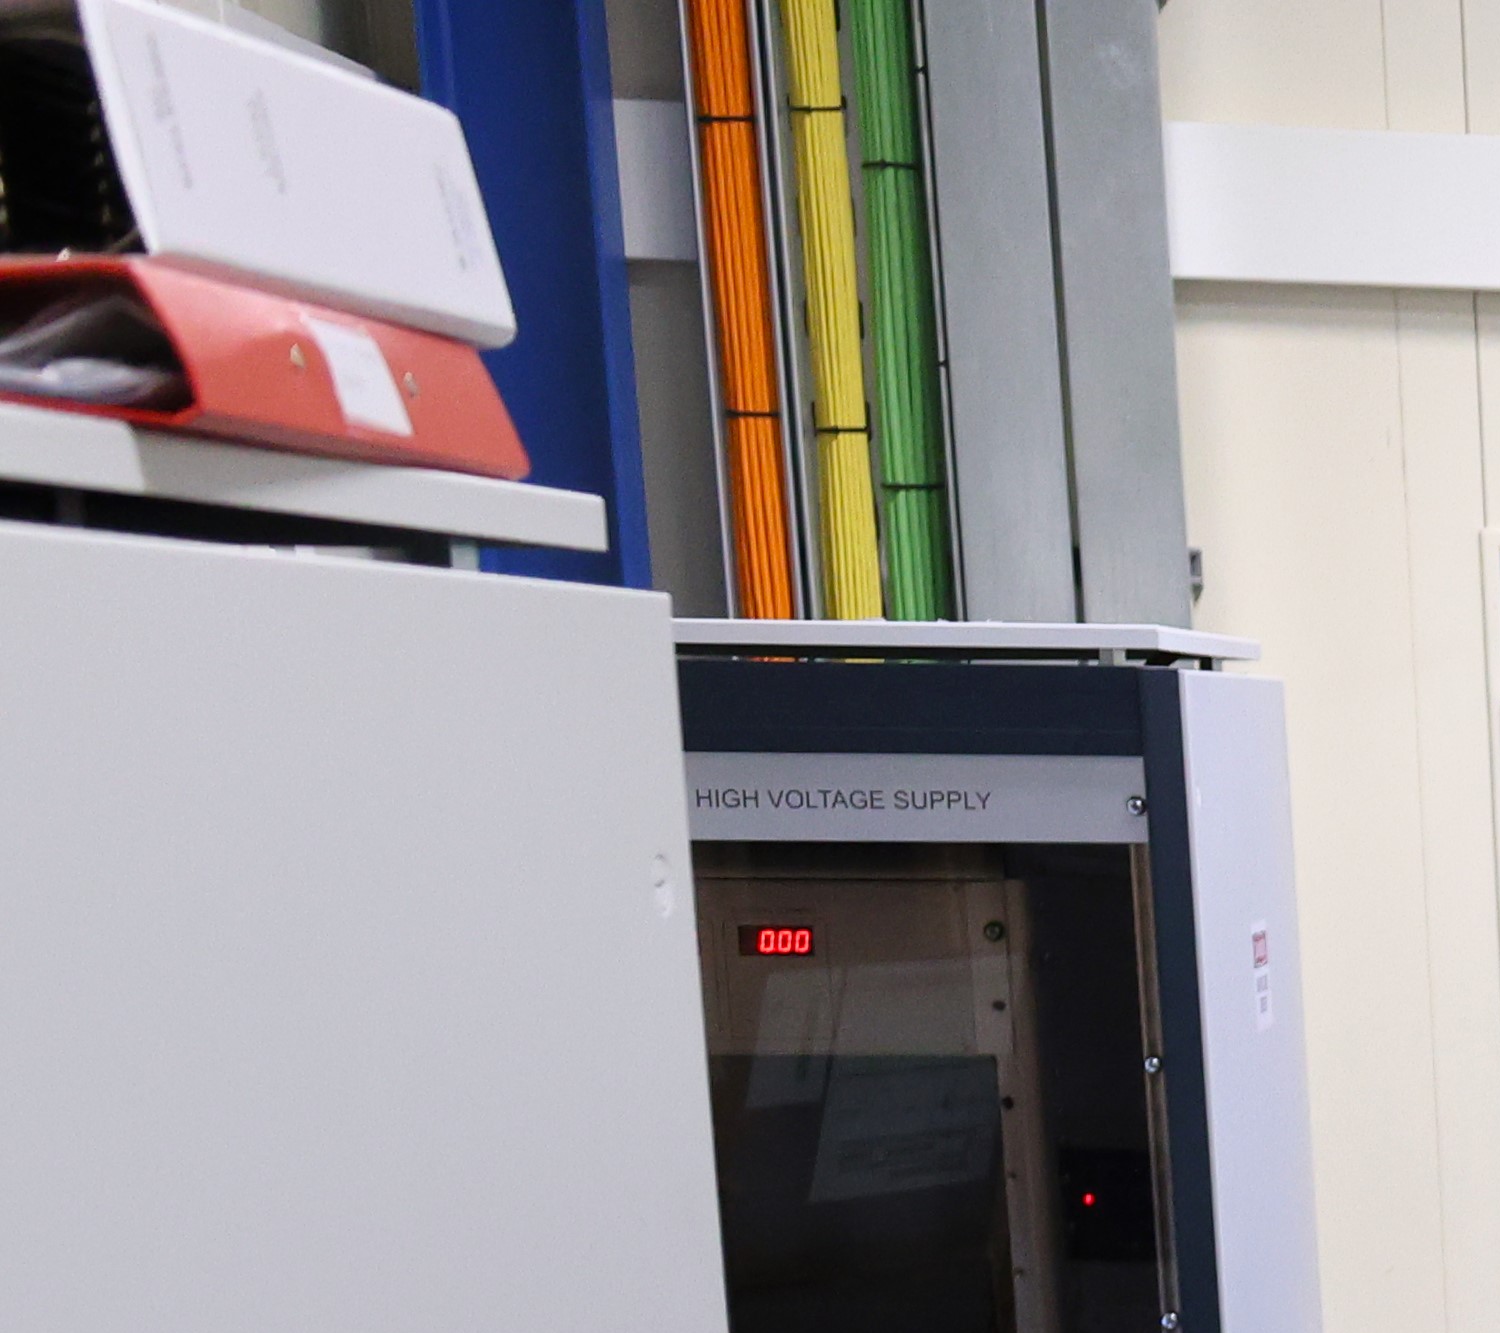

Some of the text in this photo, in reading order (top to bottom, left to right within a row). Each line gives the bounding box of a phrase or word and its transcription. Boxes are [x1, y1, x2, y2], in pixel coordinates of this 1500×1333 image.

[695, 788, 991, 811] HIGH VOLTAGE SUPPLY
